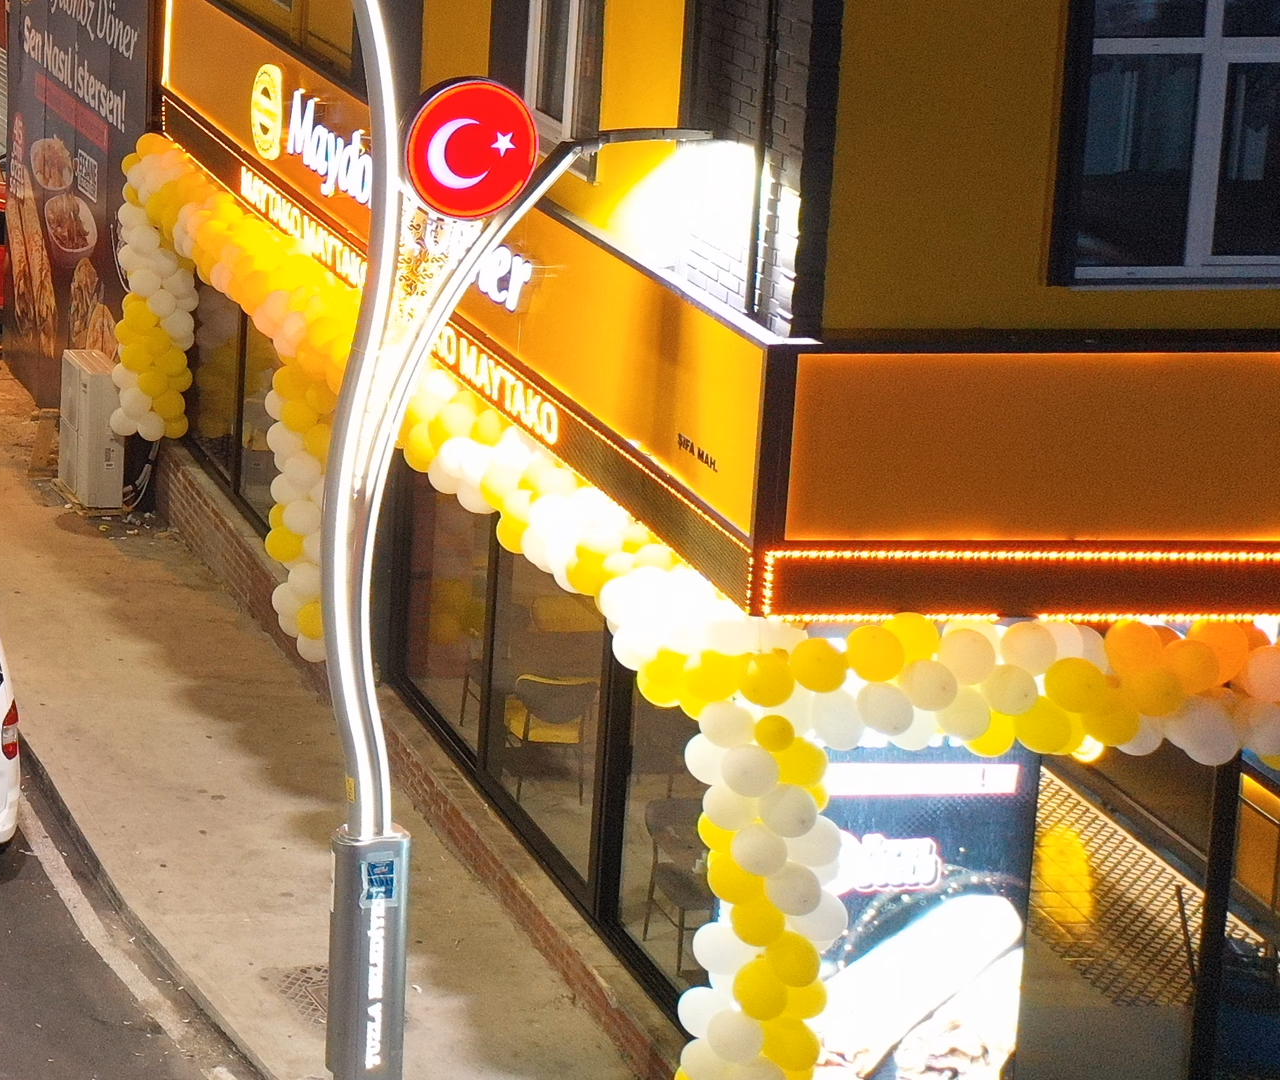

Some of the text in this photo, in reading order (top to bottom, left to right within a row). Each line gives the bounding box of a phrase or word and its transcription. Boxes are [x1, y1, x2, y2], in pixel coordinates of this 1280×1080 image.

[23, 16, 42, 63] Sen
[43, 30, 73, 90] Nasıl
[73, 41, 127, 134] İstersen!
[240, 165, 301, 239] MAYTAKO
[459, 336, 558, 445] MAYTAKO
[697, 446, 719, 473] MAH.
